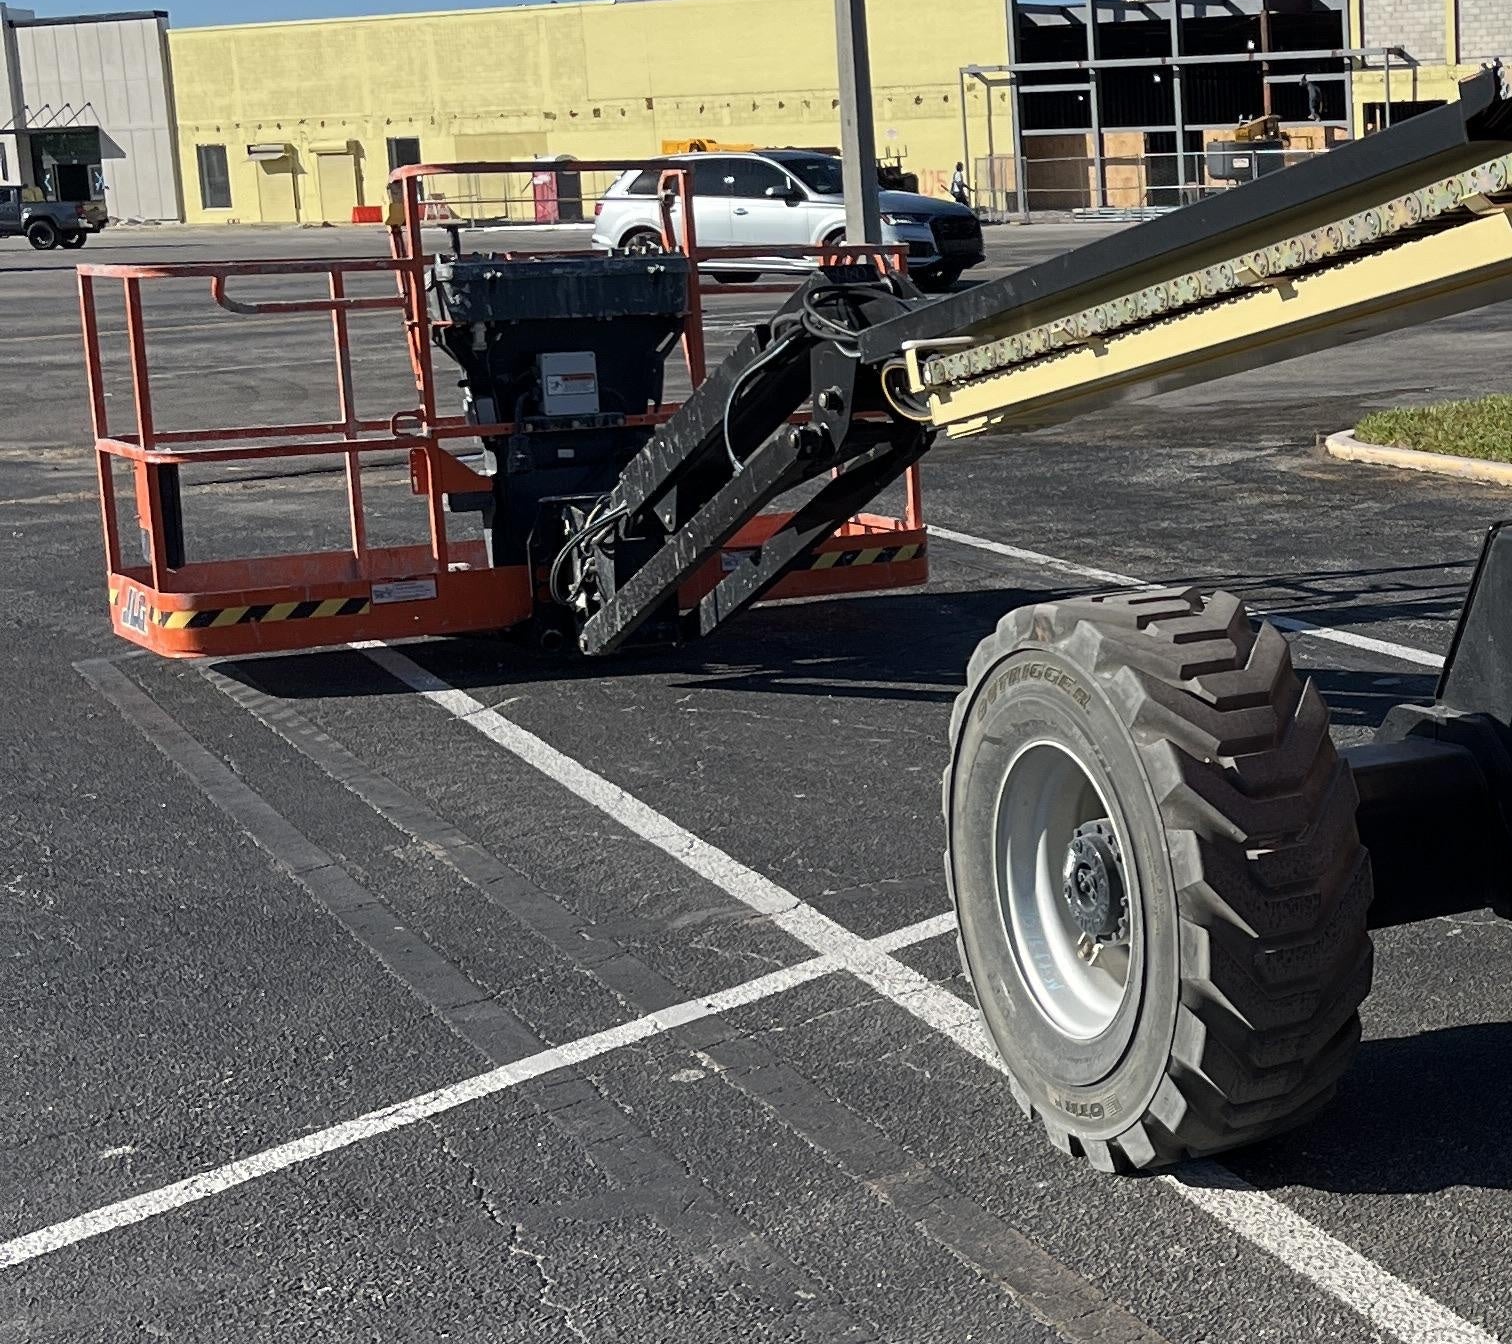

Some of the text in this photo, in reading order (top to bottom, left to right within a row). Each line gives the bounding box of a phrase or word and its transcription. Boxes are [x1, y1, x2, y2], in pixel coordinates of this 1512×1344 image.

[122, 586, 149, 636] JLG
[977, 662, 1091, 723] OUTRIGGER
[1065, 1100, 1104, 1119] OTR
